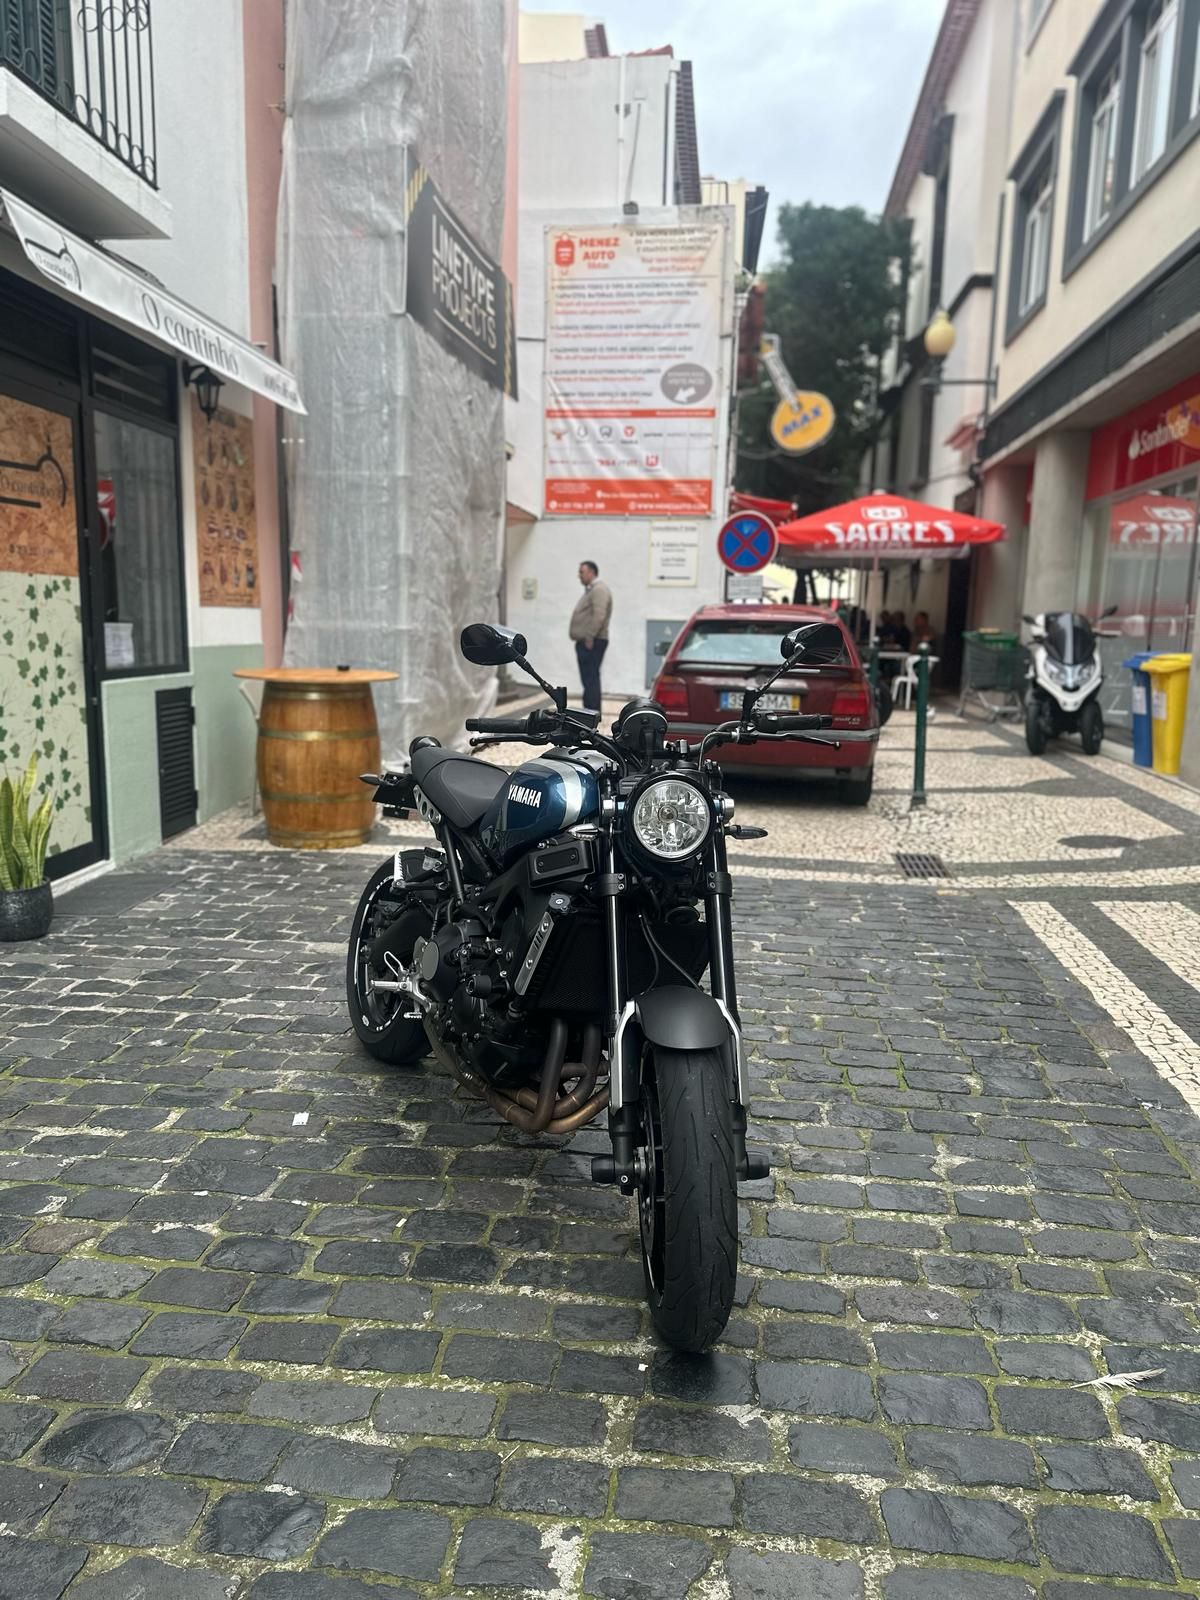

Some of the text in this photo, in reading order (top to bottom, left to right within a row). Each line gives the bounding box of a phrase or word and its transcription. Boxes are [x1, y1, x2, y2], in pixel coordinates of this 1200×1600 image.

[579, 237, 620, 248] MENEZ
[582, 250, 615, 261] AUTO
[432, 214, 495, 316] LINETYPE
[432, 258, 497, 349] PROJECTS
[142, 293, 239, 375] O cantinho
[1140, 413, 1191, 456] Santander
[823, 519, 955, 543] SAGRES
[507, 784, 542, 808] YAMAHA
